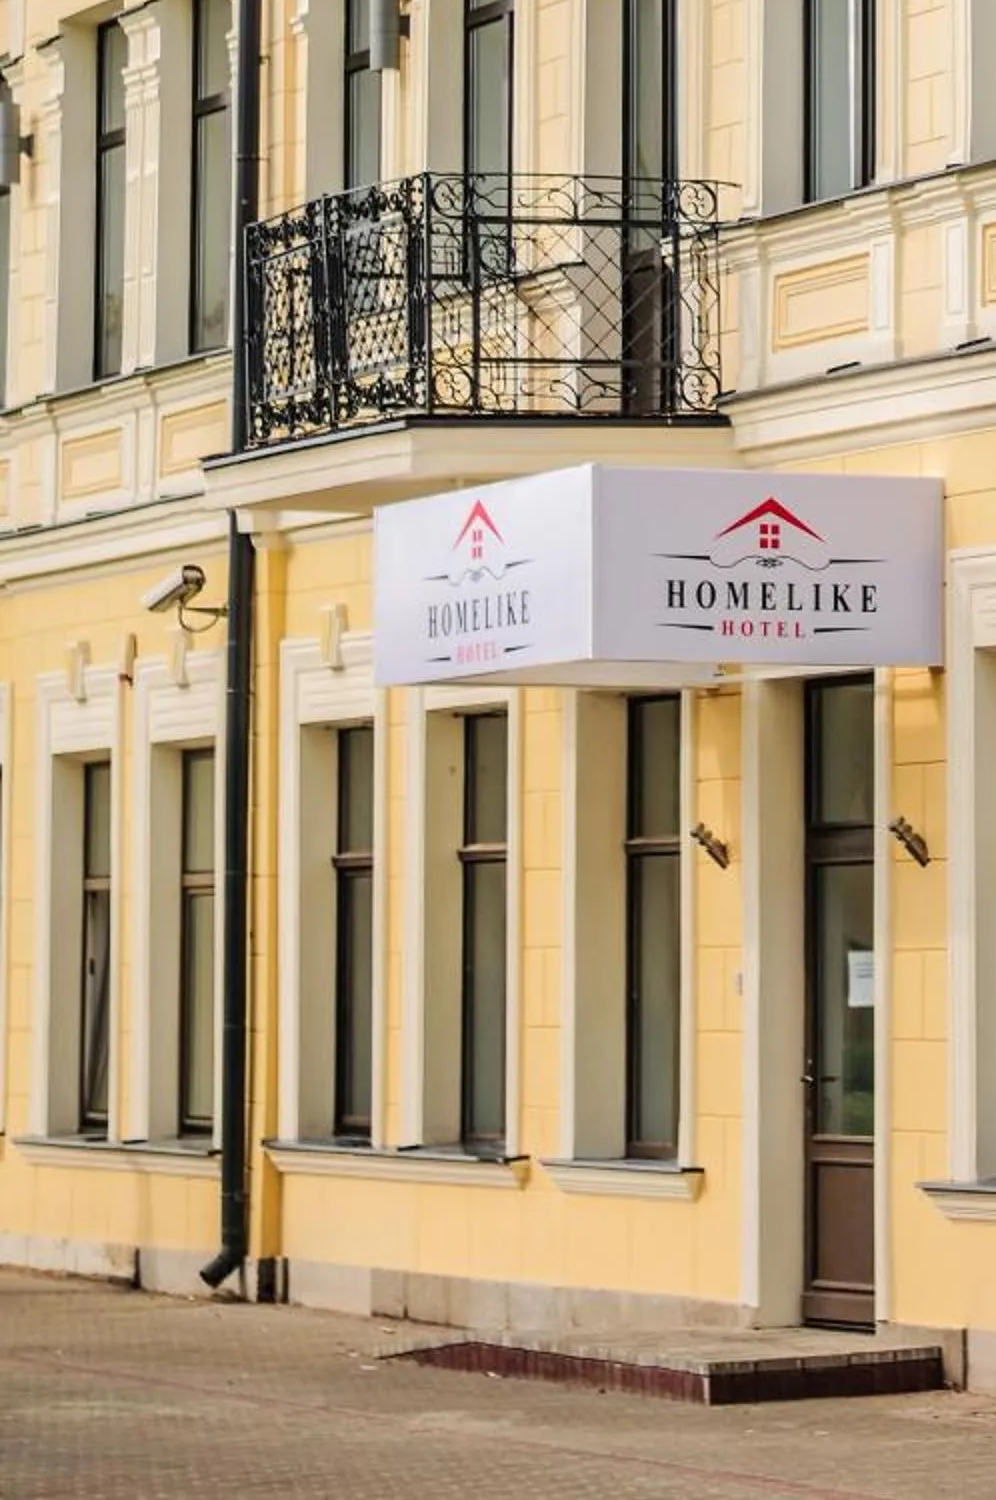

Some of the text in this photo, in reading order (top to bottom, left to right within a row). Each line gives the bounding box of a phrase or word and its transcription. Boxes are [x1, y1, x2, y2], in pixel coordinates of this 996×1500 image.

[666, 579, 878, 613] HOMELIKE
[428, 589, 530, 638] HOMELIKE
[721, 620, 806, 638] HOTEL
